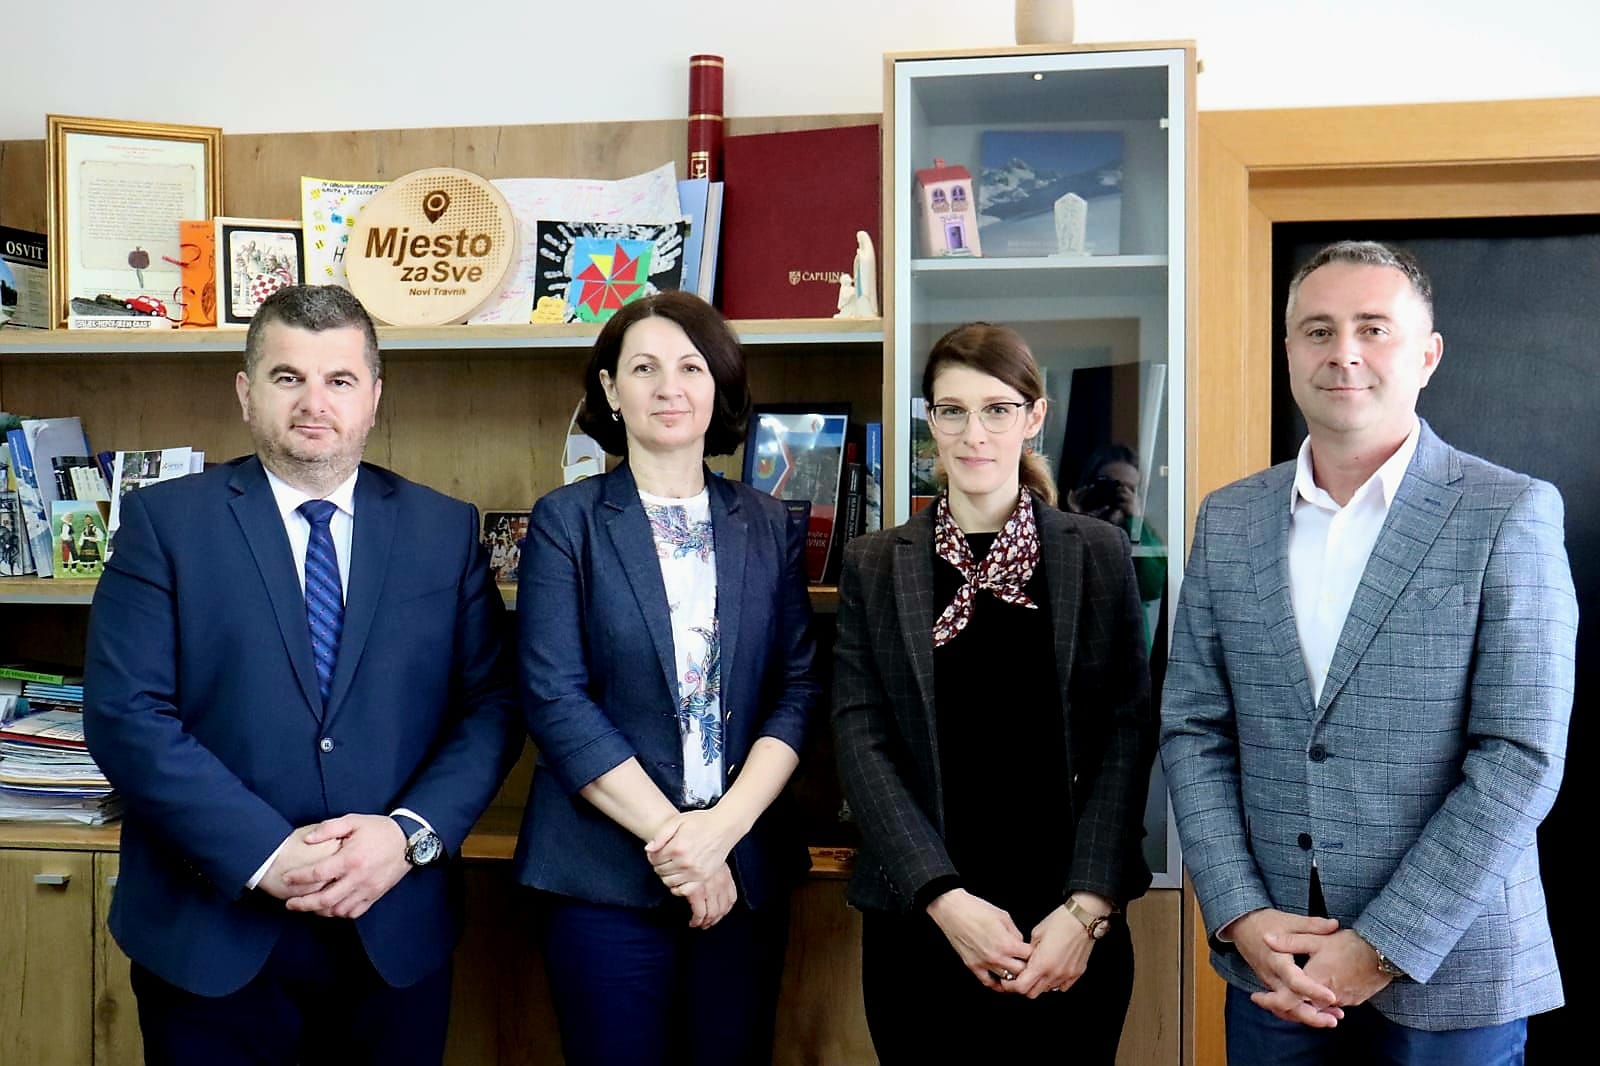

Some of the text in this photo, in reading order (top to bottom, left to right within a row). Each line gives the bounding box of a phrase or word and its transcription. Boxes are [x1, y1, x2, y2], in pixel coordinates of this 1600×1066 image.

[6, 240, 44, 260] OSVIT
[365, 227, 492, 266] Mjesto
[409, 288, 466, 296] Novi Travnik
